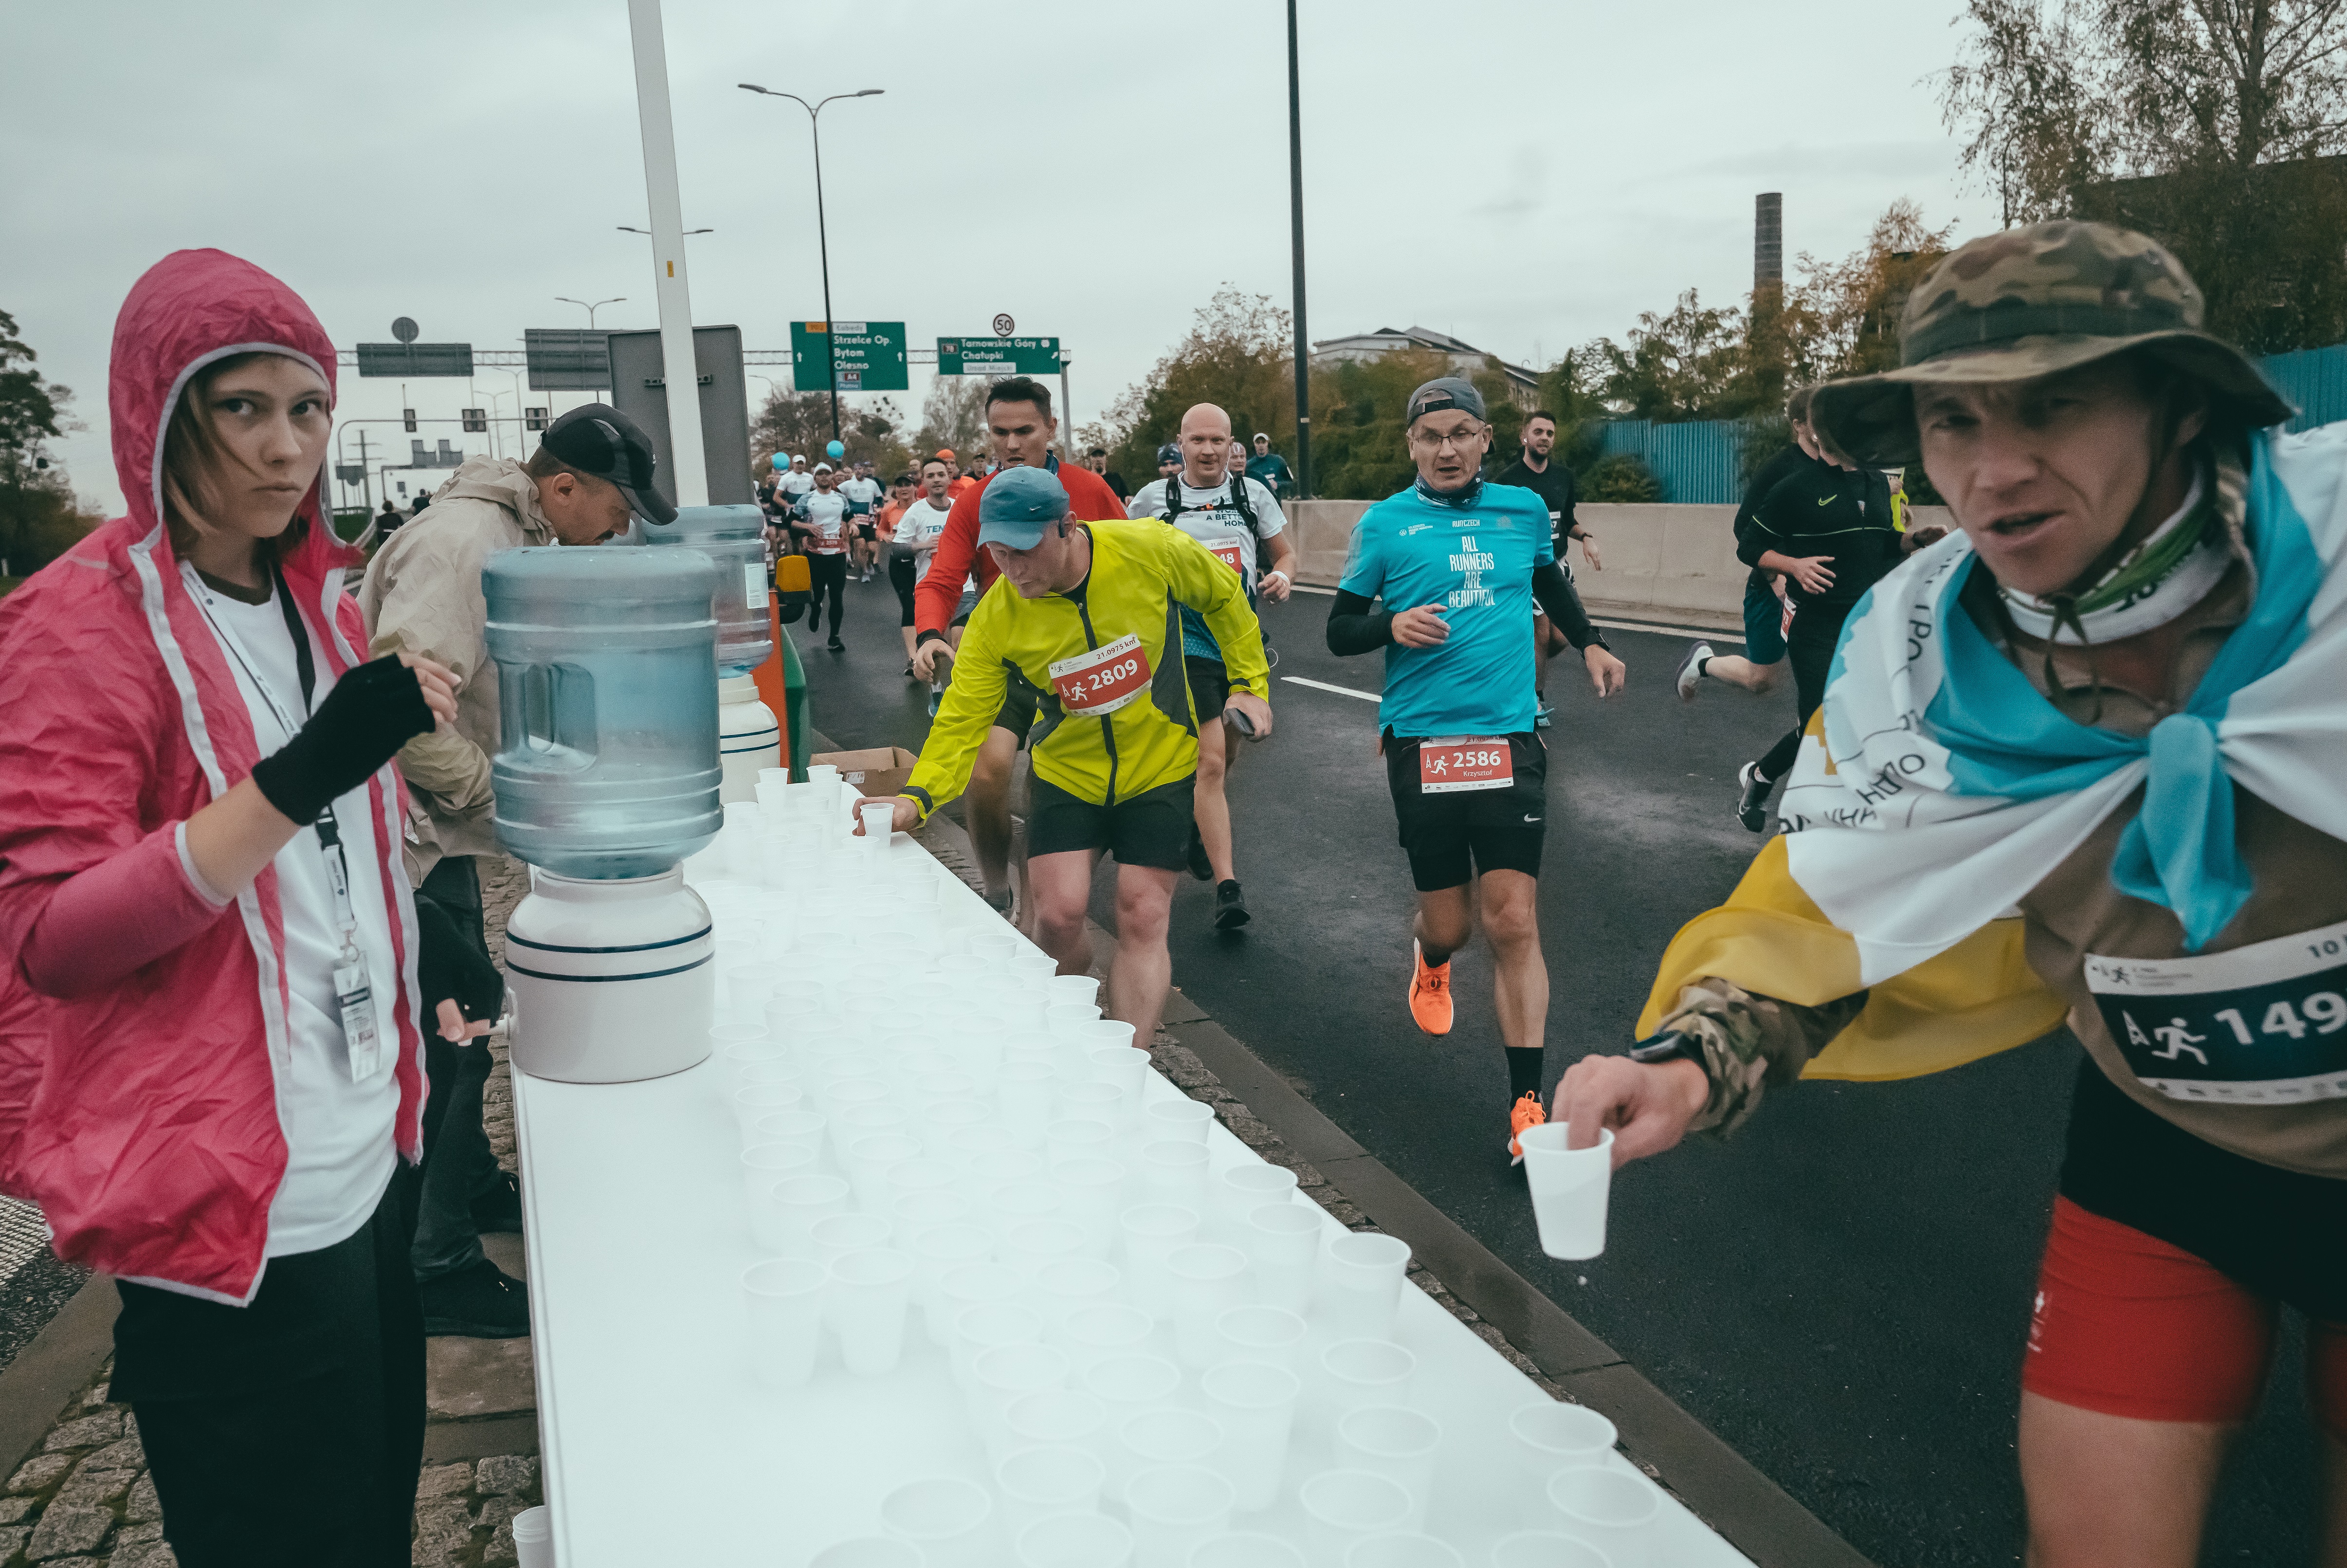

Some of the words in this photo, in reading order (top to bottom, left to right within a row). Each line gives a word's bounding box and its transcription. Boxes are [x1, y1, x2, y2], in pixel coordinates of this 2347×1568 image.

[997, 320, 1011, 331] 50
[834, 335, 872, 345] Strzelce
[874, 335, 892, 346] Op.
[961, 339, 1012, 348] Tarnowskie
[1014, 339, 1037, 349] Góry
[834, 347, 865, 359] Bytom
[962, 351, 1003, 362] Chałupki
[834, 361, 869, 370] Olesno
[1452, 519, 1480, 528] RUNCZECH
[1461, 536, 1479, 552] ALL
[1449, 552, 1495, 571] RUNNERS
[1464, 571, 1482, 589] ARE
[1096, 642, 1124, 660] 21.0975
[1124, 638, 1136, 647] km
[1088, 659, 1138, 691] 2809
[1453, 750, 1501, 768] 2586
[1463, 769, 1492, 778] Krzysztof
[2309, 938, 2340, 959] 10
[2213, 991, 2347, 1046] 149
